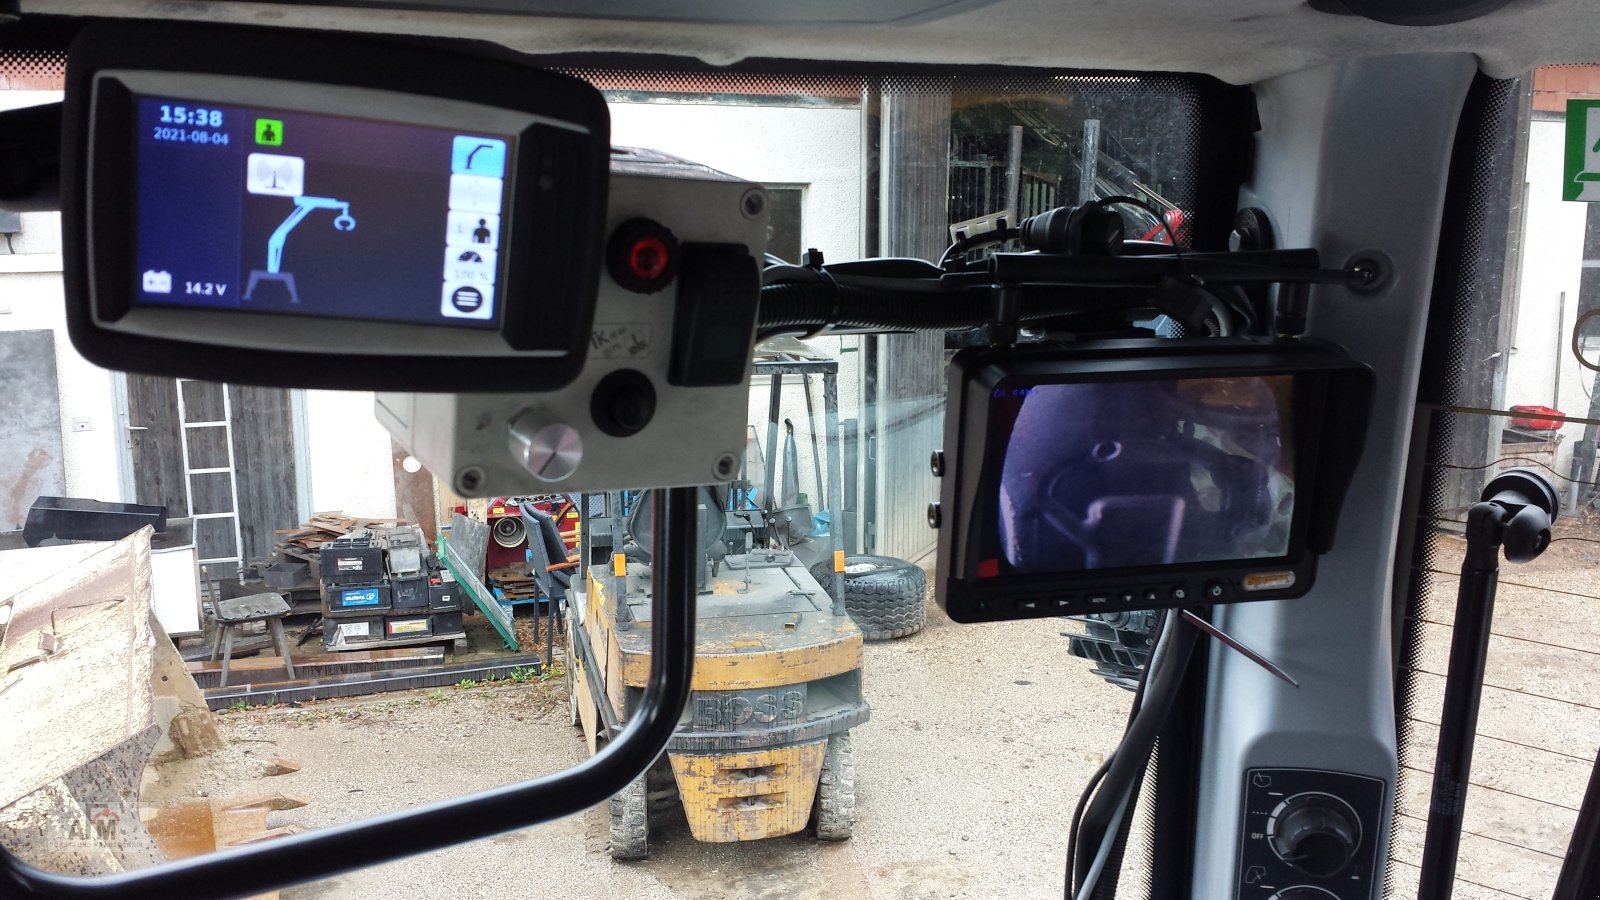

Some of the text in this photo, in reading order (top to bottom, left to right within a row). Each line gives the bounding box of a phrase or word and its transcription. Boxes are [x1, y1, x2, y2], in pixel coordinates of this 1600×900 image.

[159, 104, 224, 127] 15:38
[153, 127, 229, 146] 2021-08-04
[185, 281, 227, 296] 14.2 V
[695, 690, 804, 728] BOSS
[1251, 832, 1264, 840] OFF
